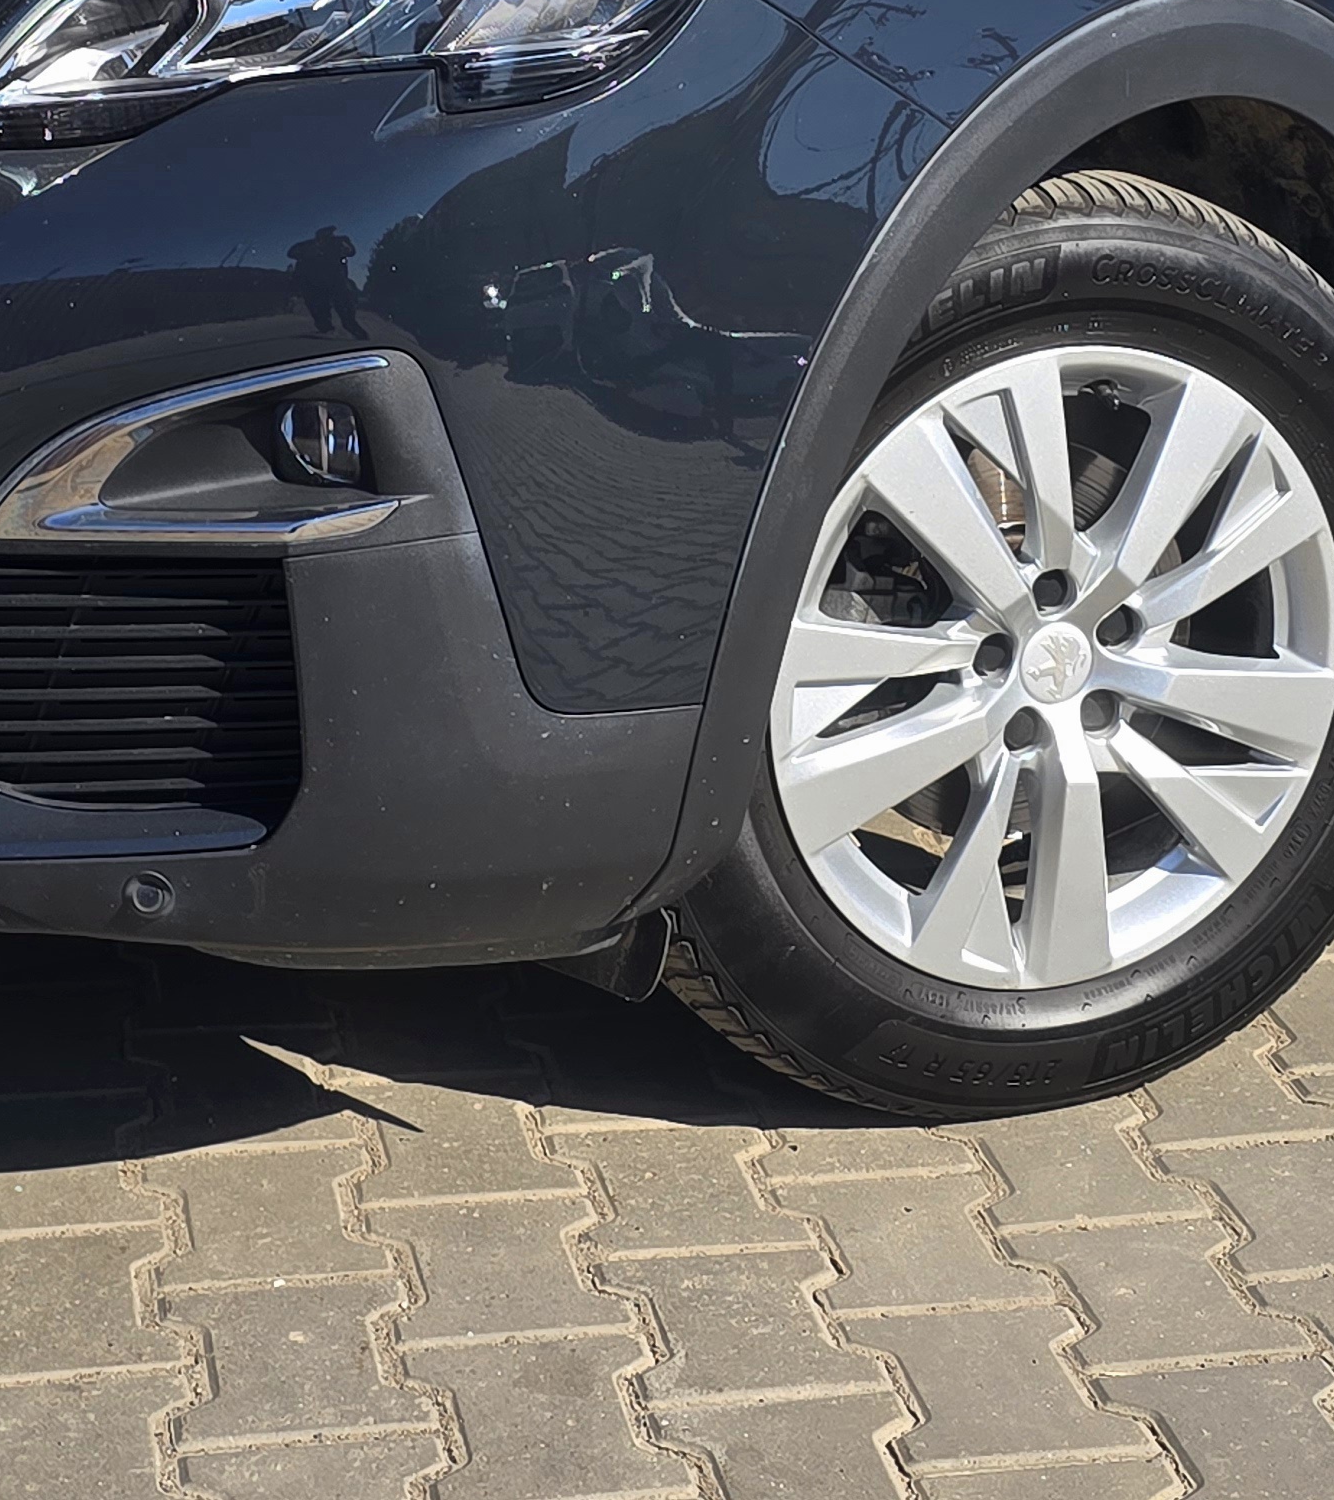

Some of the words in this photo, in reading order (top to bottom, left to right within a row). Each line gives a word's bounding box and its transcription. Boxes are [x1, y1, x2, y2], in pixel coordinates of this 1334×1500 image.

[1102, 893, 1323, 1075] MICHELIN
[923, 1052, 946, 1077] R
[949, 1057, 1062, 1087] 215/65
